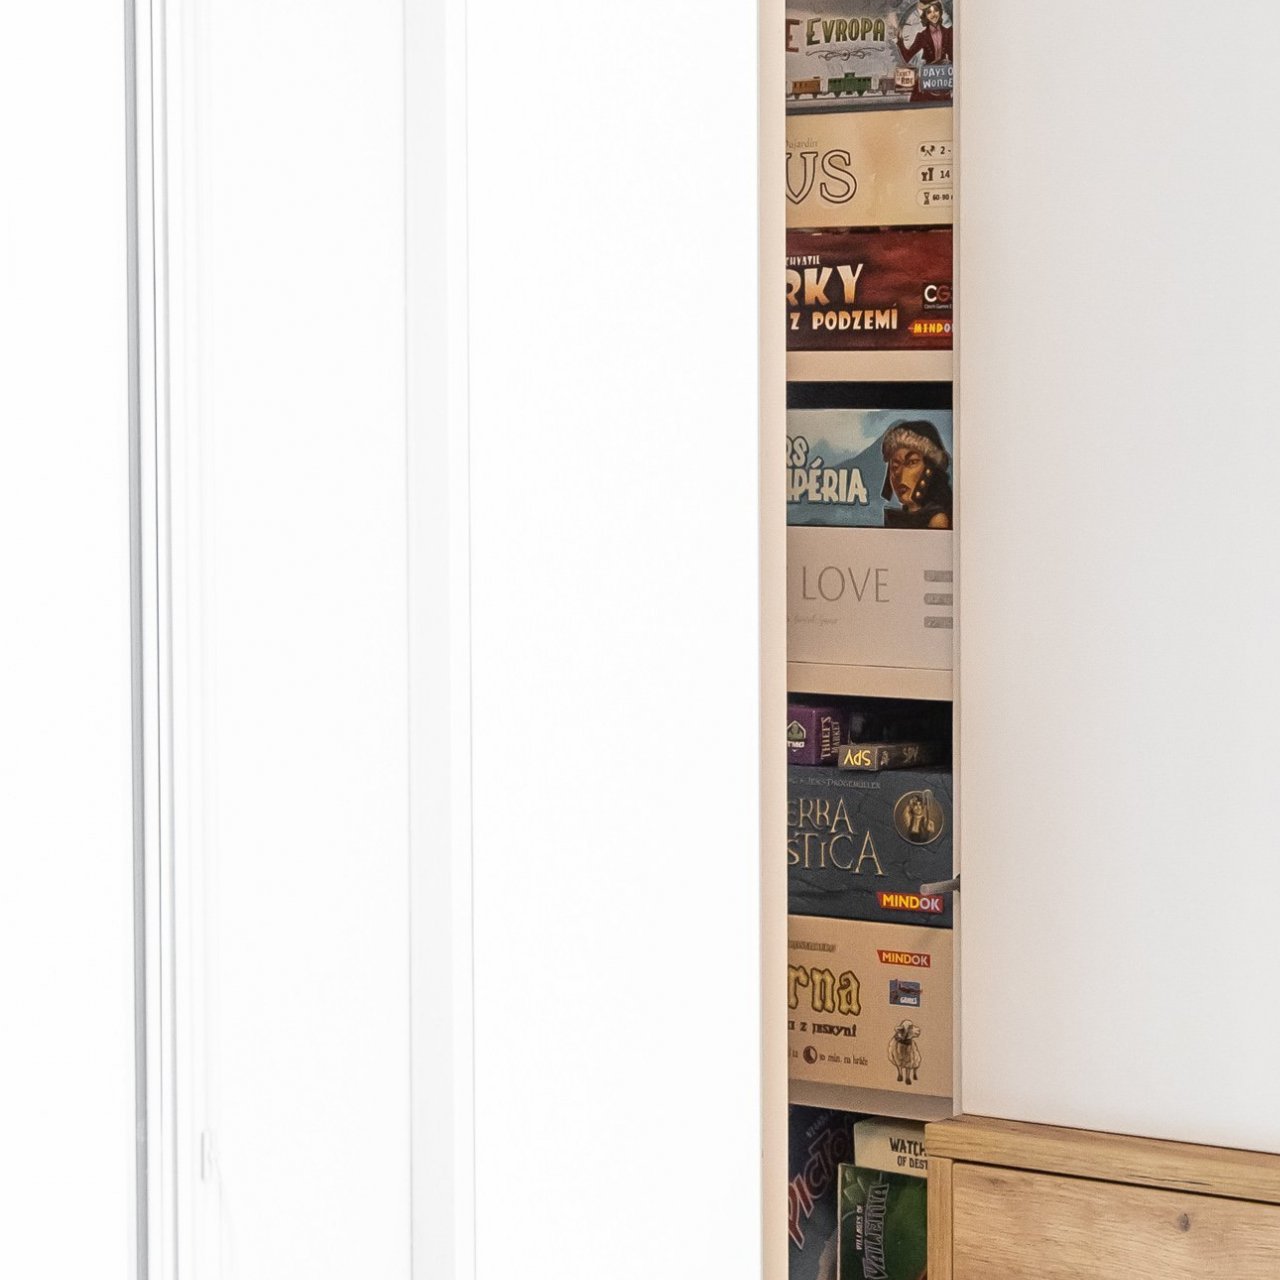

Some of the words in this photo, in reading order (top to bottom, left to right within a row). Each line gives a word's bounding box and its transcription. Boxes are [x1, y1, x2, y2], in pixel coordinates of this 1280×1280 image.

[806, 17, 885, 46] EVROPA
[923, 68, 945, 77] DAYS
[786, 149, 857, 205] US
[789, 312, 801, 330] Z
[812, 303, 898, 331] PODZEMÍ
[914, 323, 953, 333] MINDO
[802, 566, 889, 602] LOVE
[843, 749, 872, 766] SPY
[882, 893, 941, 911] MINDOK
[882, 951, 929, 966] MINDOK
[897, 1155, 907, 1167] OF
